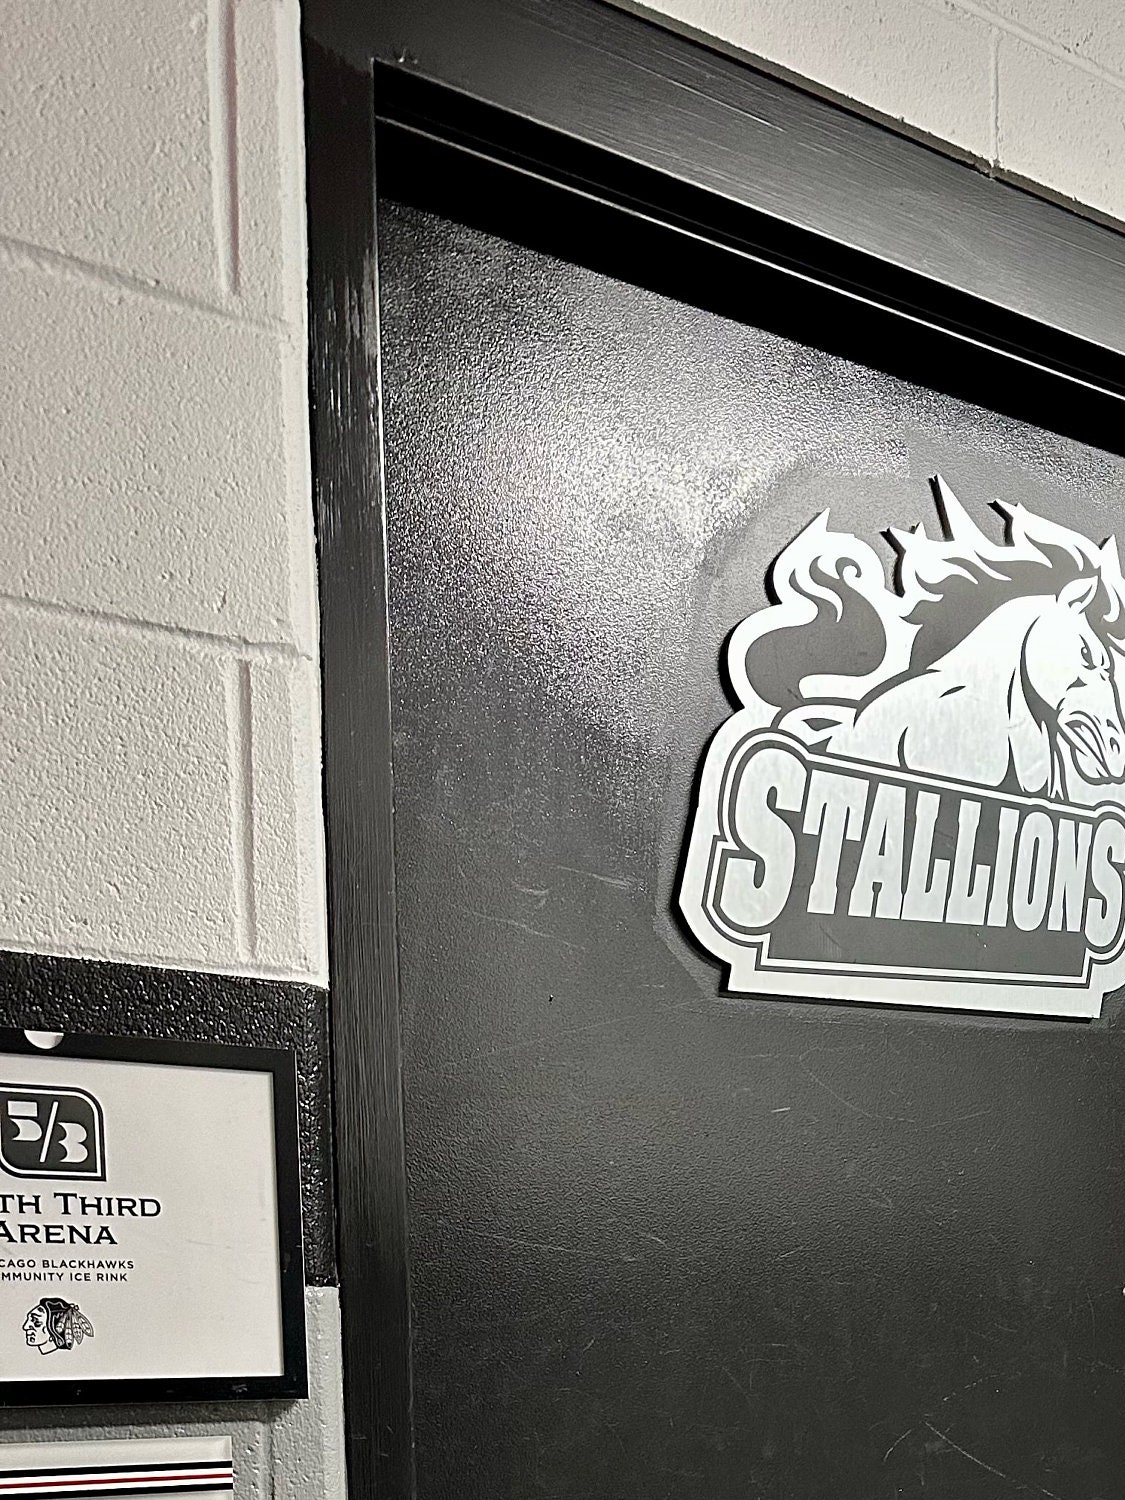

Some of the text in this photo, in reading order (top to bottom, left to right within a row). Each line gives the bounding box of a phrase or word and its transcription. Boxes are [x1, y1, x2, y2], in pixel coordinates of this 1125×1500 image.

[53, 1192, 162, 1217] THIRD
[0, 1220, 118, 1245] ARENA
[42, 1259, 134, 1270] BLACKHAWKS
[70, 1272, 91, 1282] ICE
[97, 1272, 128, 1282] RINK
